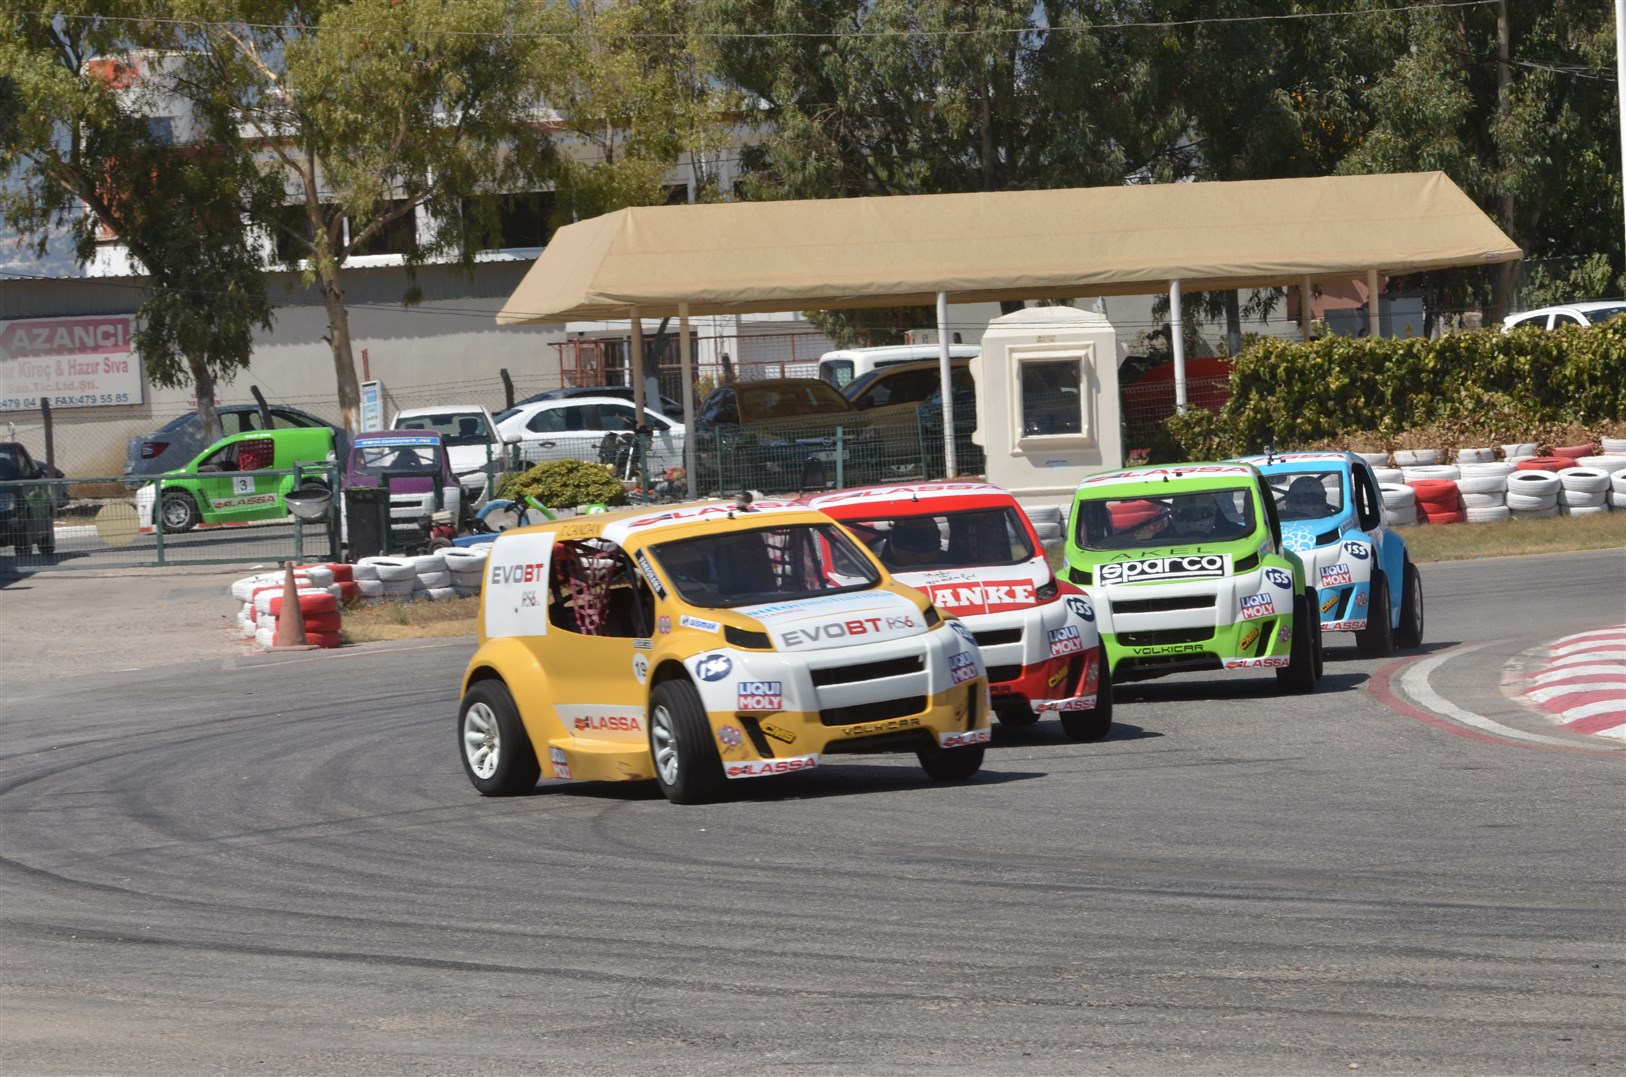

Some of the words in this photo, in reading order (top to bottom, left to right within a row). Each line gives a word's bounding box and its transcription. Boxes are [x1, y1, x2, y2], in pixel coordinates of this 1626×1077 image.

[55, 360, 64, 376] &
[104, 357, 129, 374] Sıva
[1121, 466, 1248, 478] LASSA
[239, 479, 248, 491] 3
[862, 484, 1001, 497] LASSA
[1110, 546, 1213, 561] AKEL
[491, 563, 545, 585] EVOBT
[1101, 555, 1223, 583] sparco
[1321, 564, 1349, 576] LIQUI
[1322, 573, 1352, 586] MOLY
[1241, 593, 1272, 607] LIQUI
[1243, 604, 1275, 619] MOLY
[780, 617, 881, 647] EVOBT
[1324, 620, 1367, 631] LASSA
[1049, 626, 1079, 642] LIQUI
[1051, 639, 1083, 655] MOLY
[1132, 643, 1205, 656] VOLKICAR
[1242, 658, 1289, 669] LASSA
[739, 682, 781, 696] LIQUI
[739, 696, 782, 709] MOLY
[590, 715, 642, 732] LASSA
[746, 757, 817, 775] LASSA
